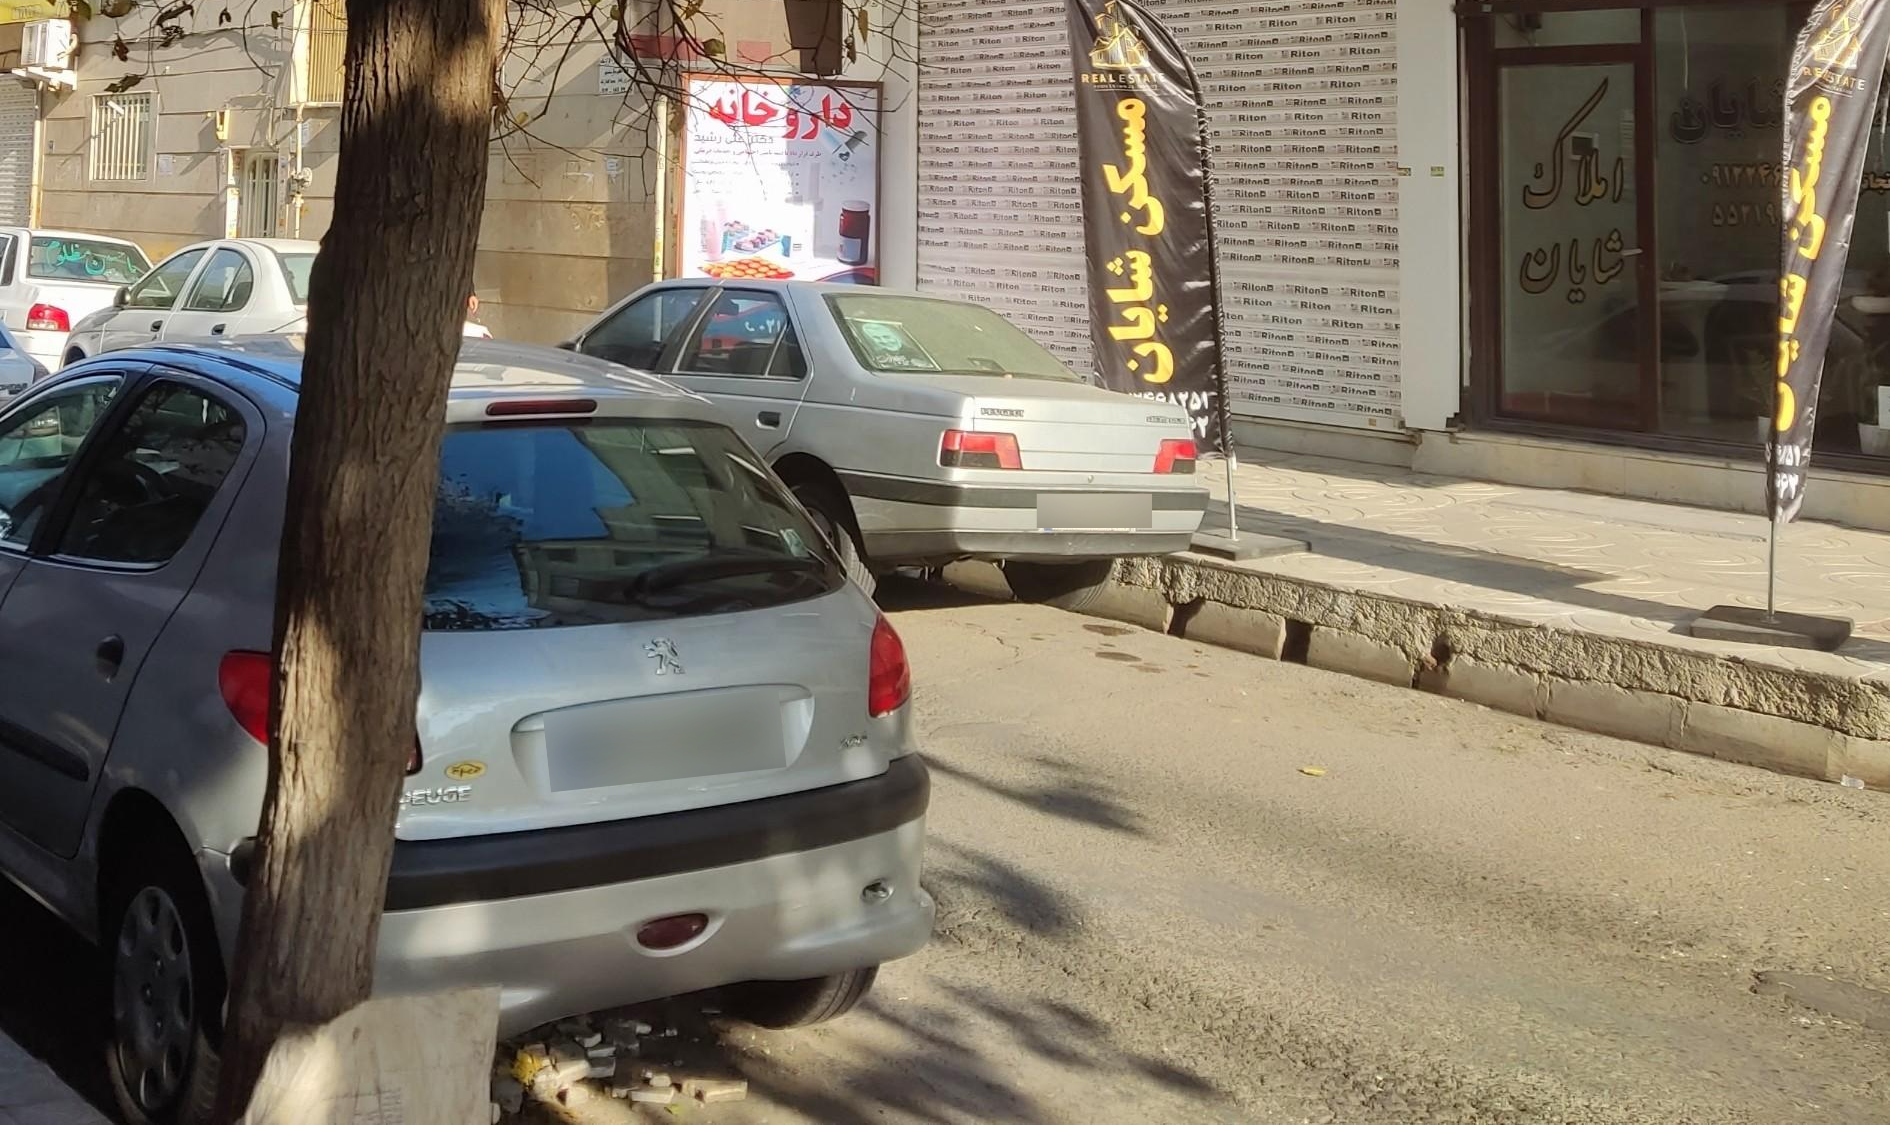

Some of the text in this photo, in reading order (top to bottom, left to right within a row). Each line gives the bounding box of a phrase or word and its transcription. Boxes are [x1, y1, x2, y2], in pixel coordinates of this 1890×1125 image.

[1269, 19, 1297, 27] Riton
[1326, 15, 1355, 23] Riton
[1290, 50, 1320, 58] Riton
[1349, 47, 1380, 55] Riton
[1081, 73, 1166, 84] REAL ESTATE
[708, 88, 853, 140] داروخانه
[1523, 76, 1624, 212] املاک
[1102, 97, 1166, 237] مسکن
[1347, 208, 1375, 216] Riton
[1267, 222, 1294, 230] Riton
[1328, 241, 1355, 249] Riton
[1519, 229, 1624, 304] شایان
[1242, 283, 1268, 291] Riton
[1295, 286, 1321, 294] Riton
[1350, 288, 1378, 297] Riton
[1243, 298, 1272, 306] Riton
[1300, 301, 1331, 310] Riton
[1361, 305, 1392, 314] Riton
[1105, 250, 1174, 385] شایان
[1272, 316, 1302, 325] Riton
[1332, 320, 1363, 329] Riton
